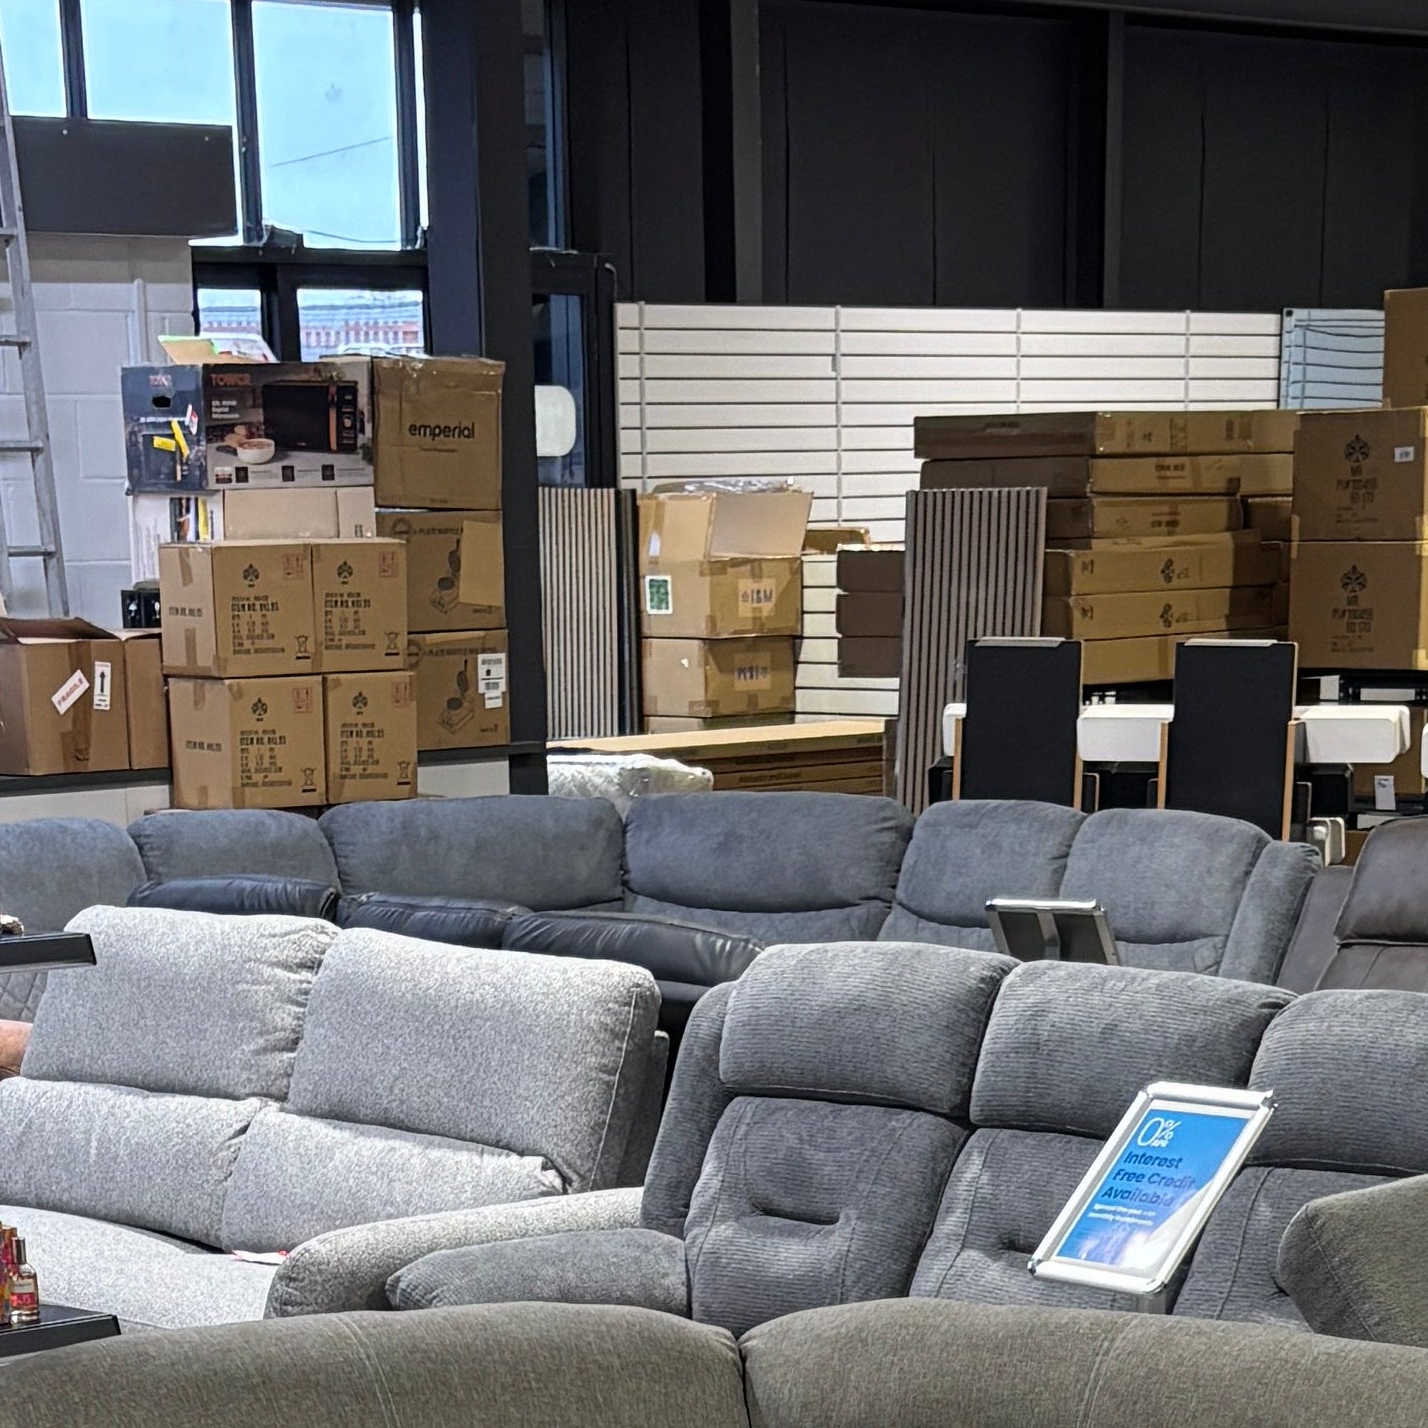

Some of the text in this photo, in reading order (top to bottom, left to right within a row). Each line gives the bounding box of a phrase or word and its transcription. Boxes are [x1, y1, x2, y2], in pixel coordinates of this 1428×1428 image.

[210, 373, 252, 387] TOWER
[408, 421, 476, 441] emperial
[1124, 1152, 1183, 1169] Interest
[1112, 1168, 1196, 1189] Free Credit
[1101, 1186, 1175, 1206] Available
